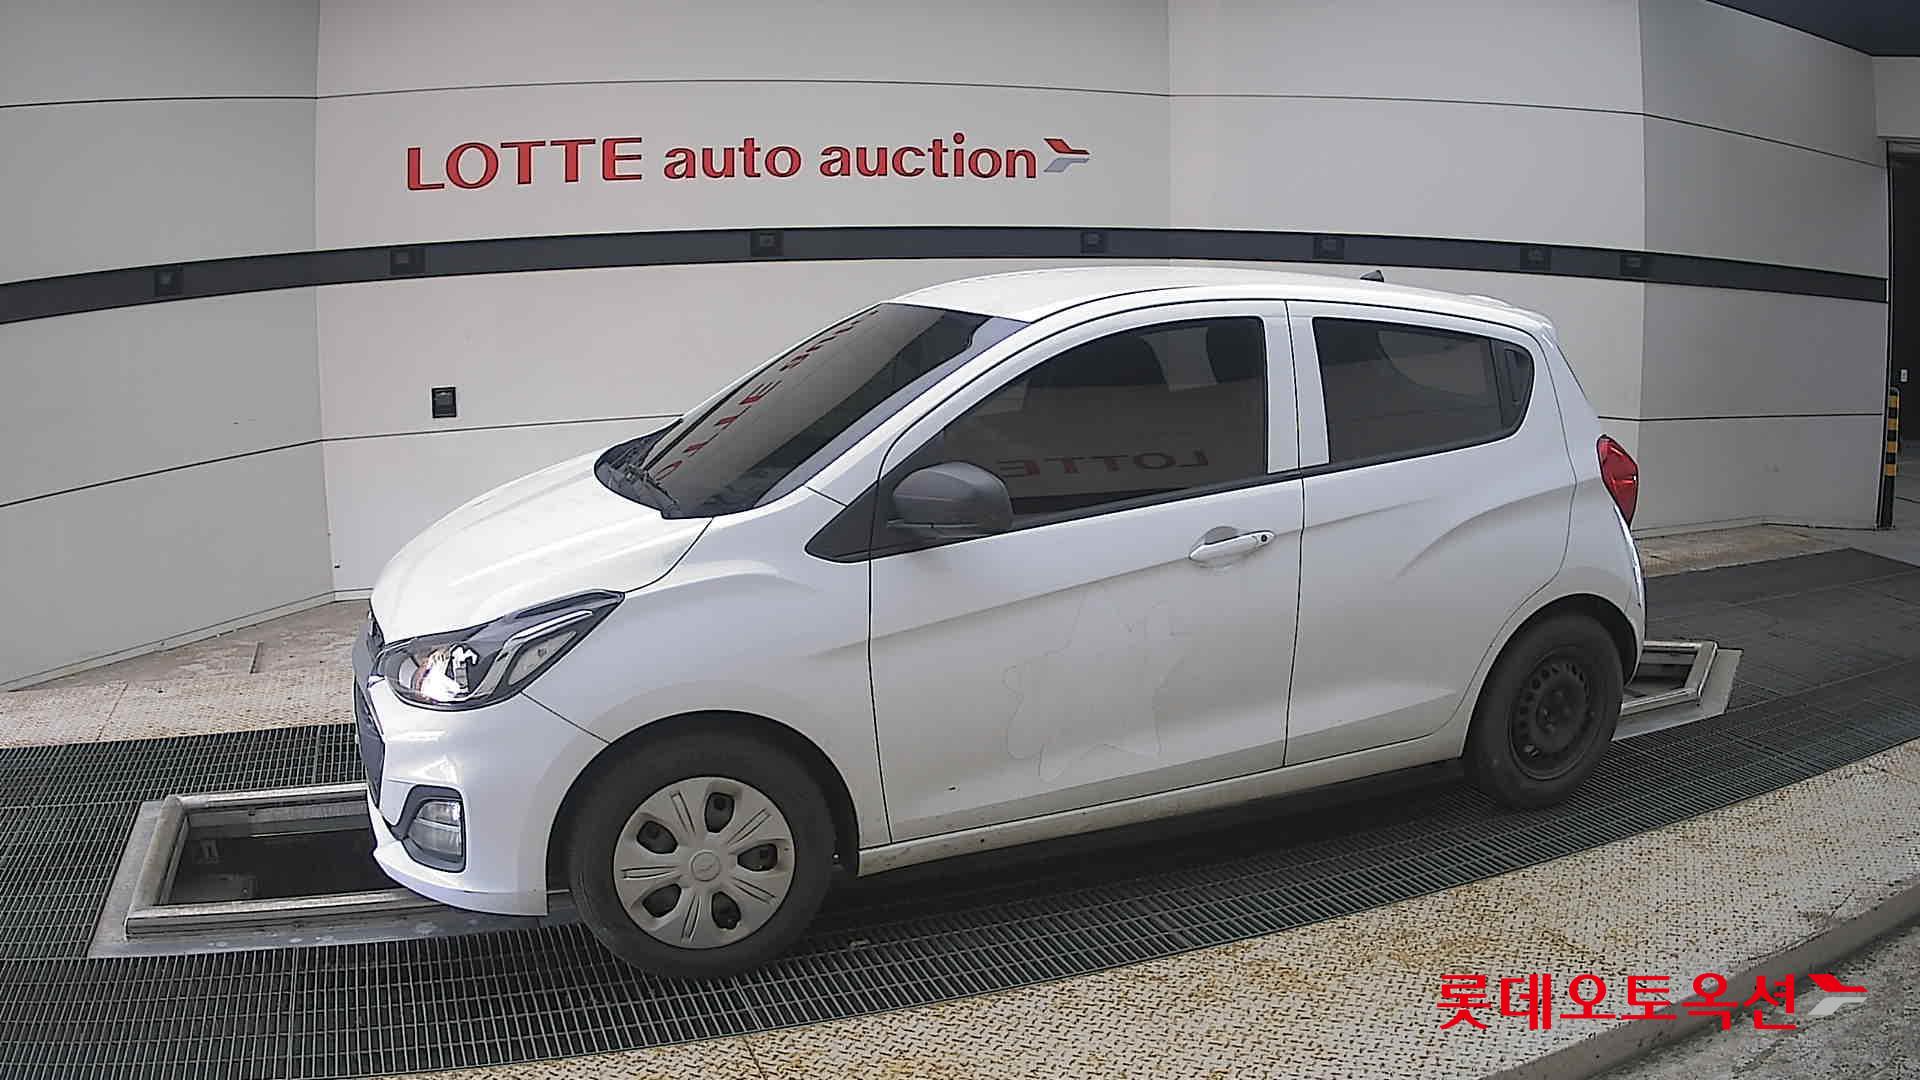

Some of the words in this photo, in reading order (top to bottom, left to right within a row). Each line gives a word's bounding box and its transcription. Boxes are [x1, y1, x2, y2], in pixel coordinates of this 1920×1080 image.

[407, 137, 641, 191] LOTTE
[663, 137, 801, 181] auto
[818, 132, 1037, 179] auction
